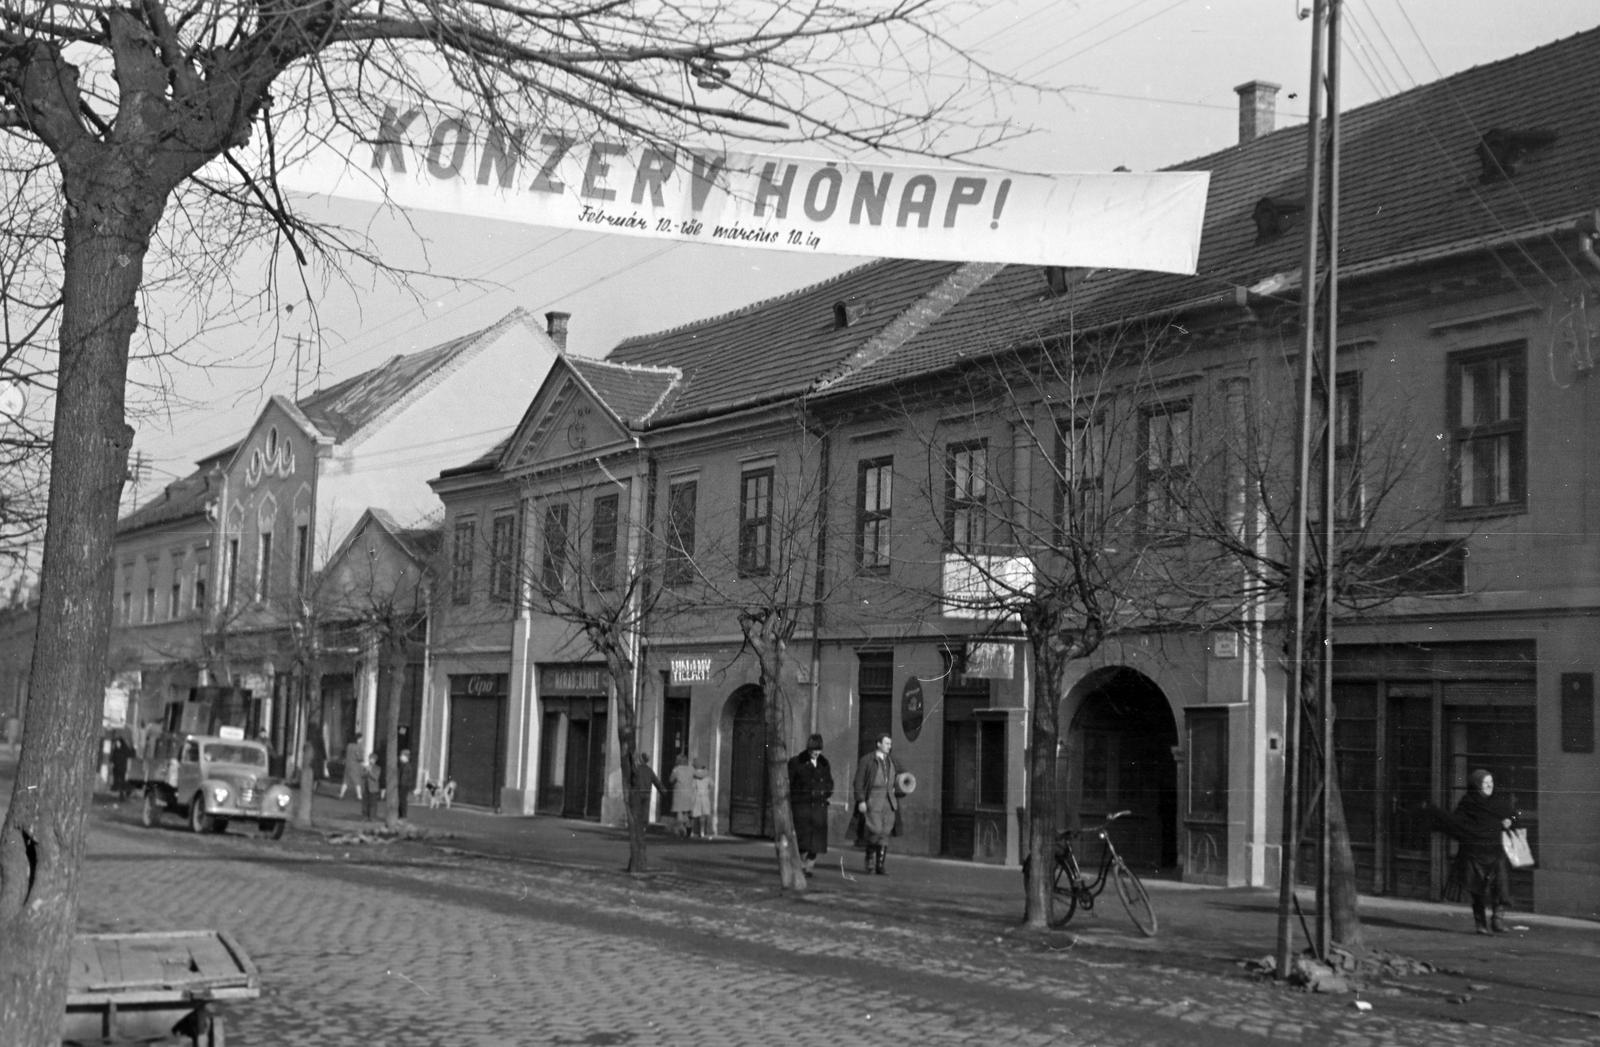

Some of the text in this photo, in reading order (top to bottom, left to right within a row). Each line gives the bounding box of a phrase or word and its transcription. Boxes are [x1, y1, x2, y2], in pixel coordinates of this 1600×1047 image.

[371, 105, 1012, 230] KONZERV HÓNAP!
[578, 204, 647, 229] Február
[713, 221, 779, 243] március
